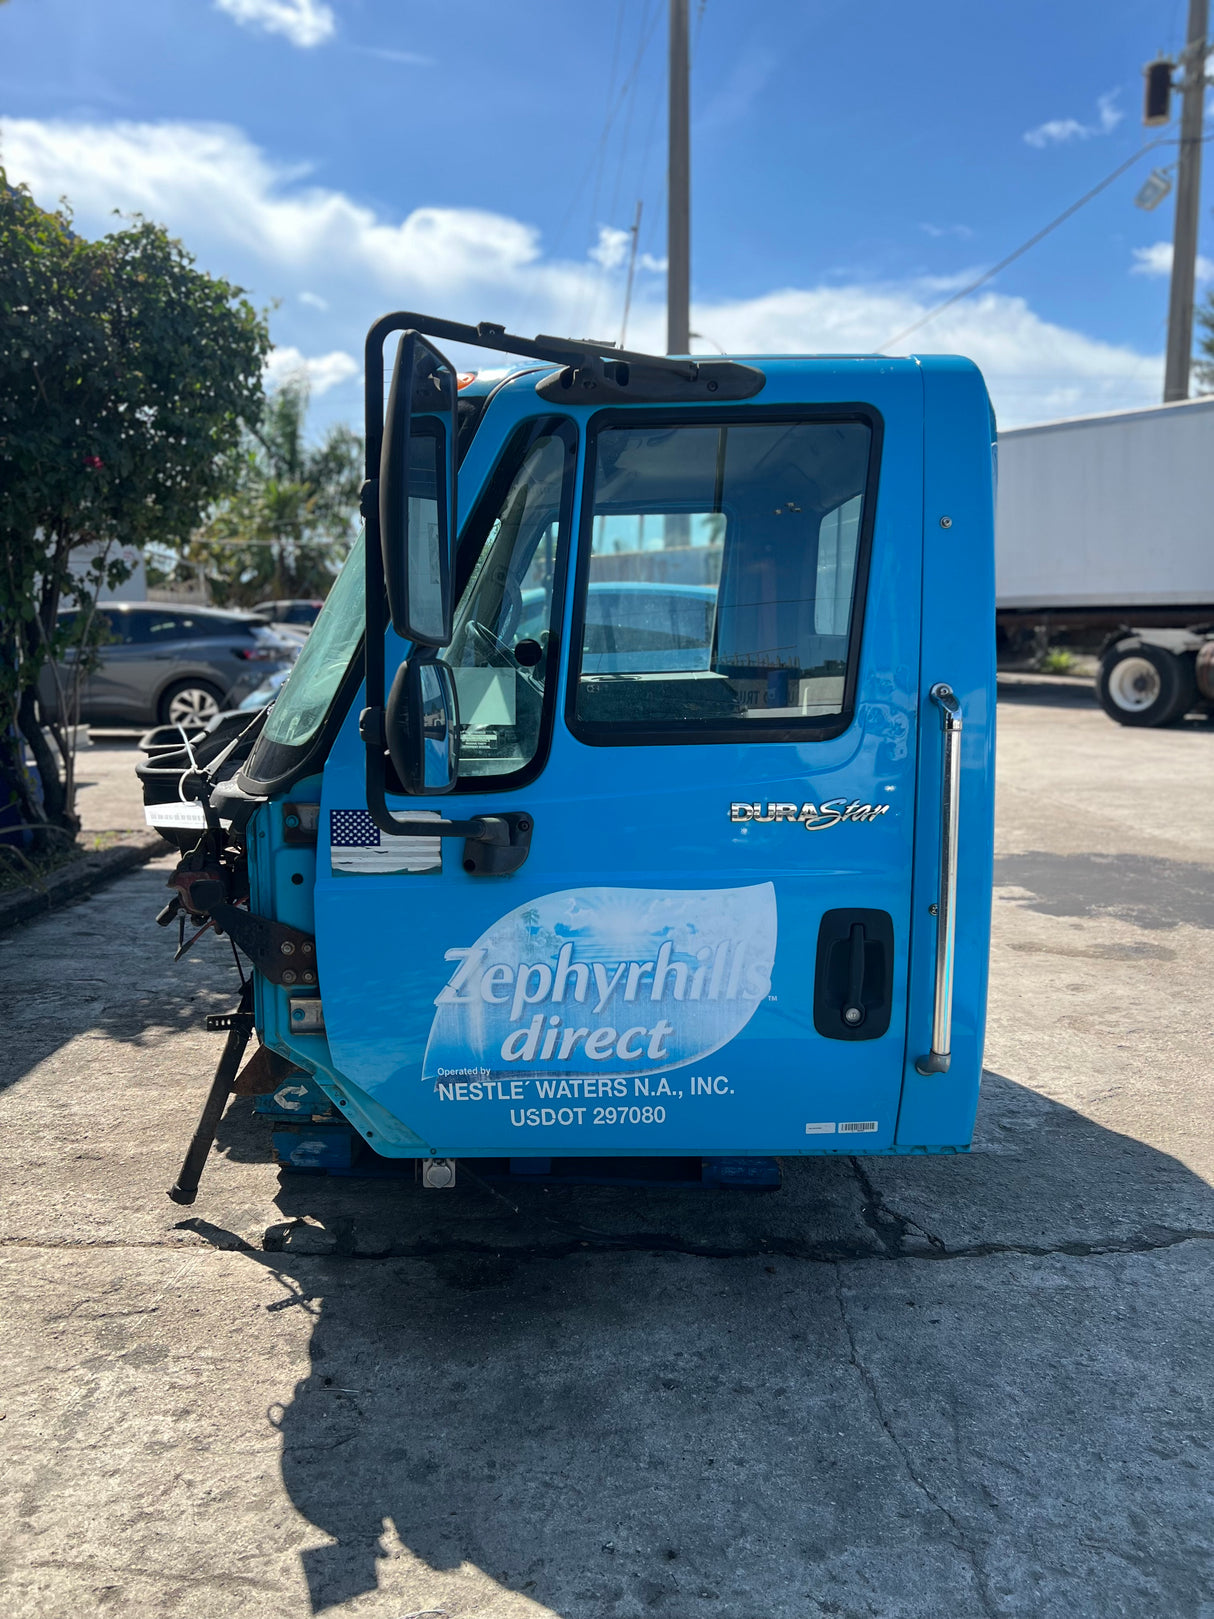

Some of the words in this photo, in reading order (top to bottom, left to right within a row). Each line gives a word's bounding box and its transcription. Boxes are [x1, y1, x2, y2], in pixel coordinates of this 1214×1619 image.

[731, 797, 890, 831] DURAStar
[434, 940, 772, 1021] Zephyrhills
[501, 1014, 674, 1062] direct
[437, 1067, 478, 1077] Operated
[480, 1067, 491, 1076] by
[535, 1078, 628, 1099] WATERS
[634, 1077, 684, 1099] N.A.,
[690, 1075, 735, 1095] INC.
[510, 1107, 587, 1127] USDOT
[593, 1106, 667, 1125] 297080
